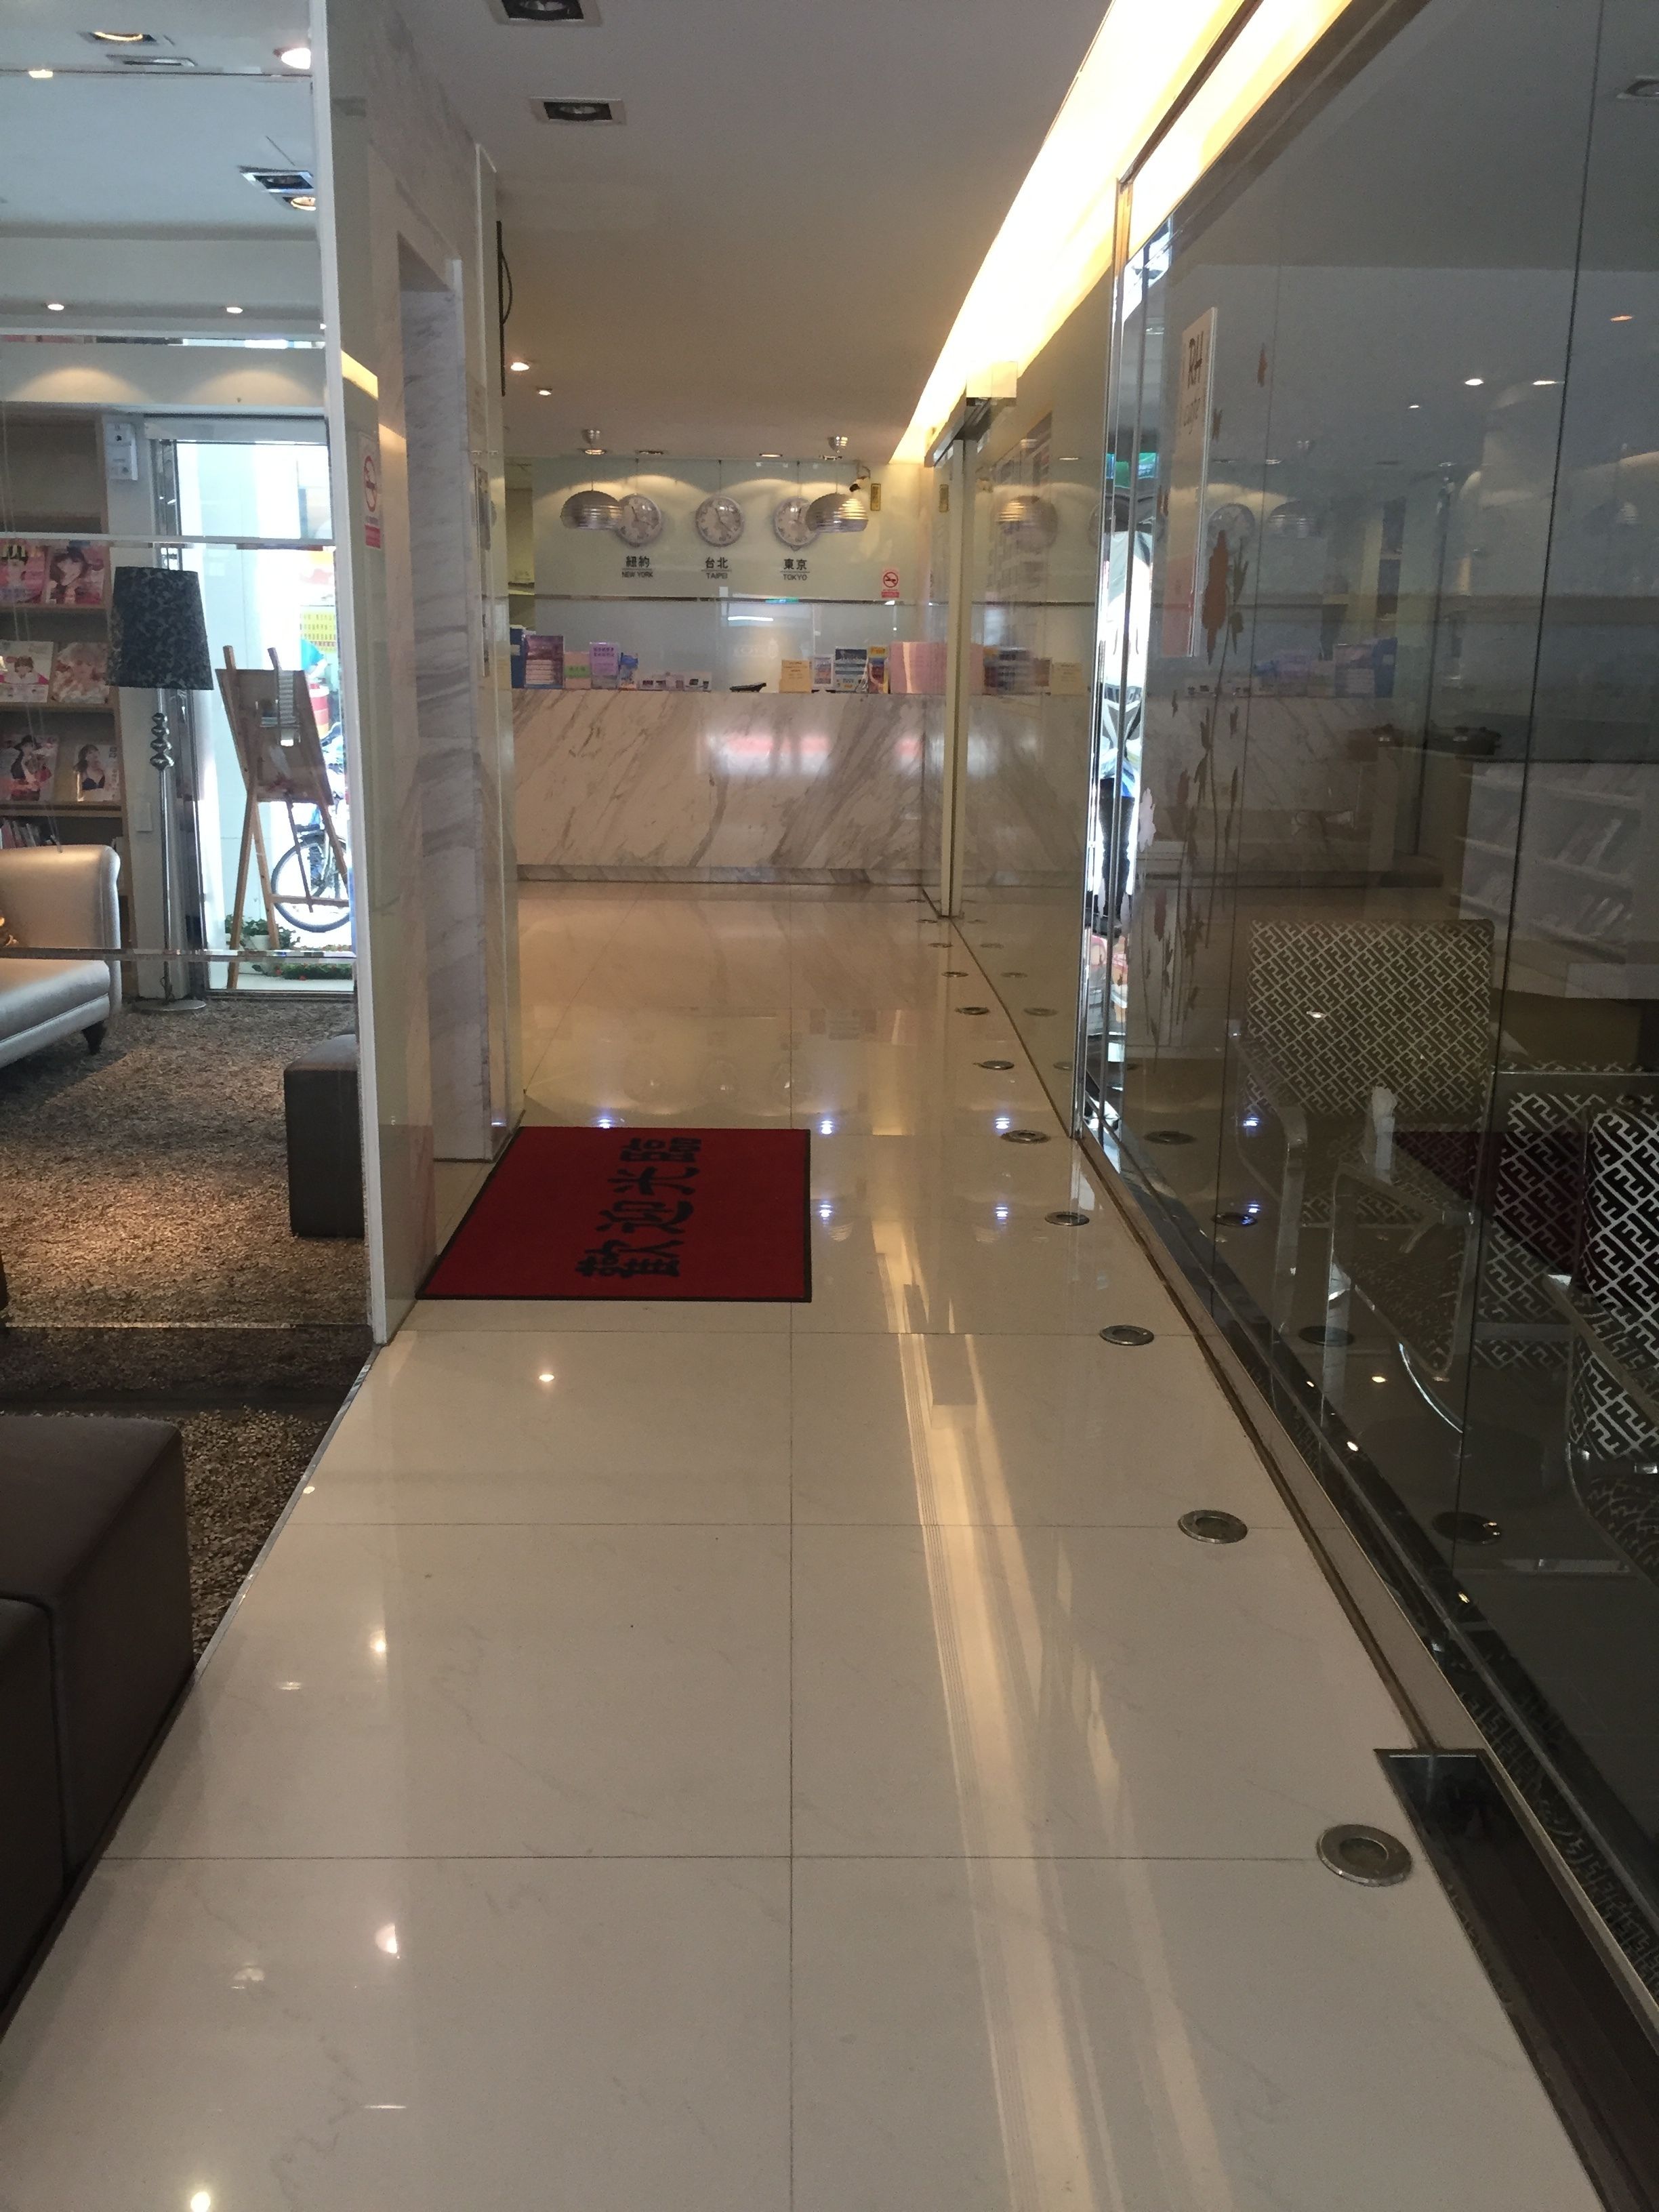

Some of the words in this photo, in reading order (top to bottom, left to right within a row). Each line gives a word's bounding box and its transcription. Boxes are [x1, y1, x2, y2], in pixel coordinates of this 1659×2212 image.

[626, 556, 650, 567] 紐約
[705, 557, 729, 569] 台北
[783, 558, 807, 571] 東京
[575, 1139, 701, 1277] 歡迎光臨
